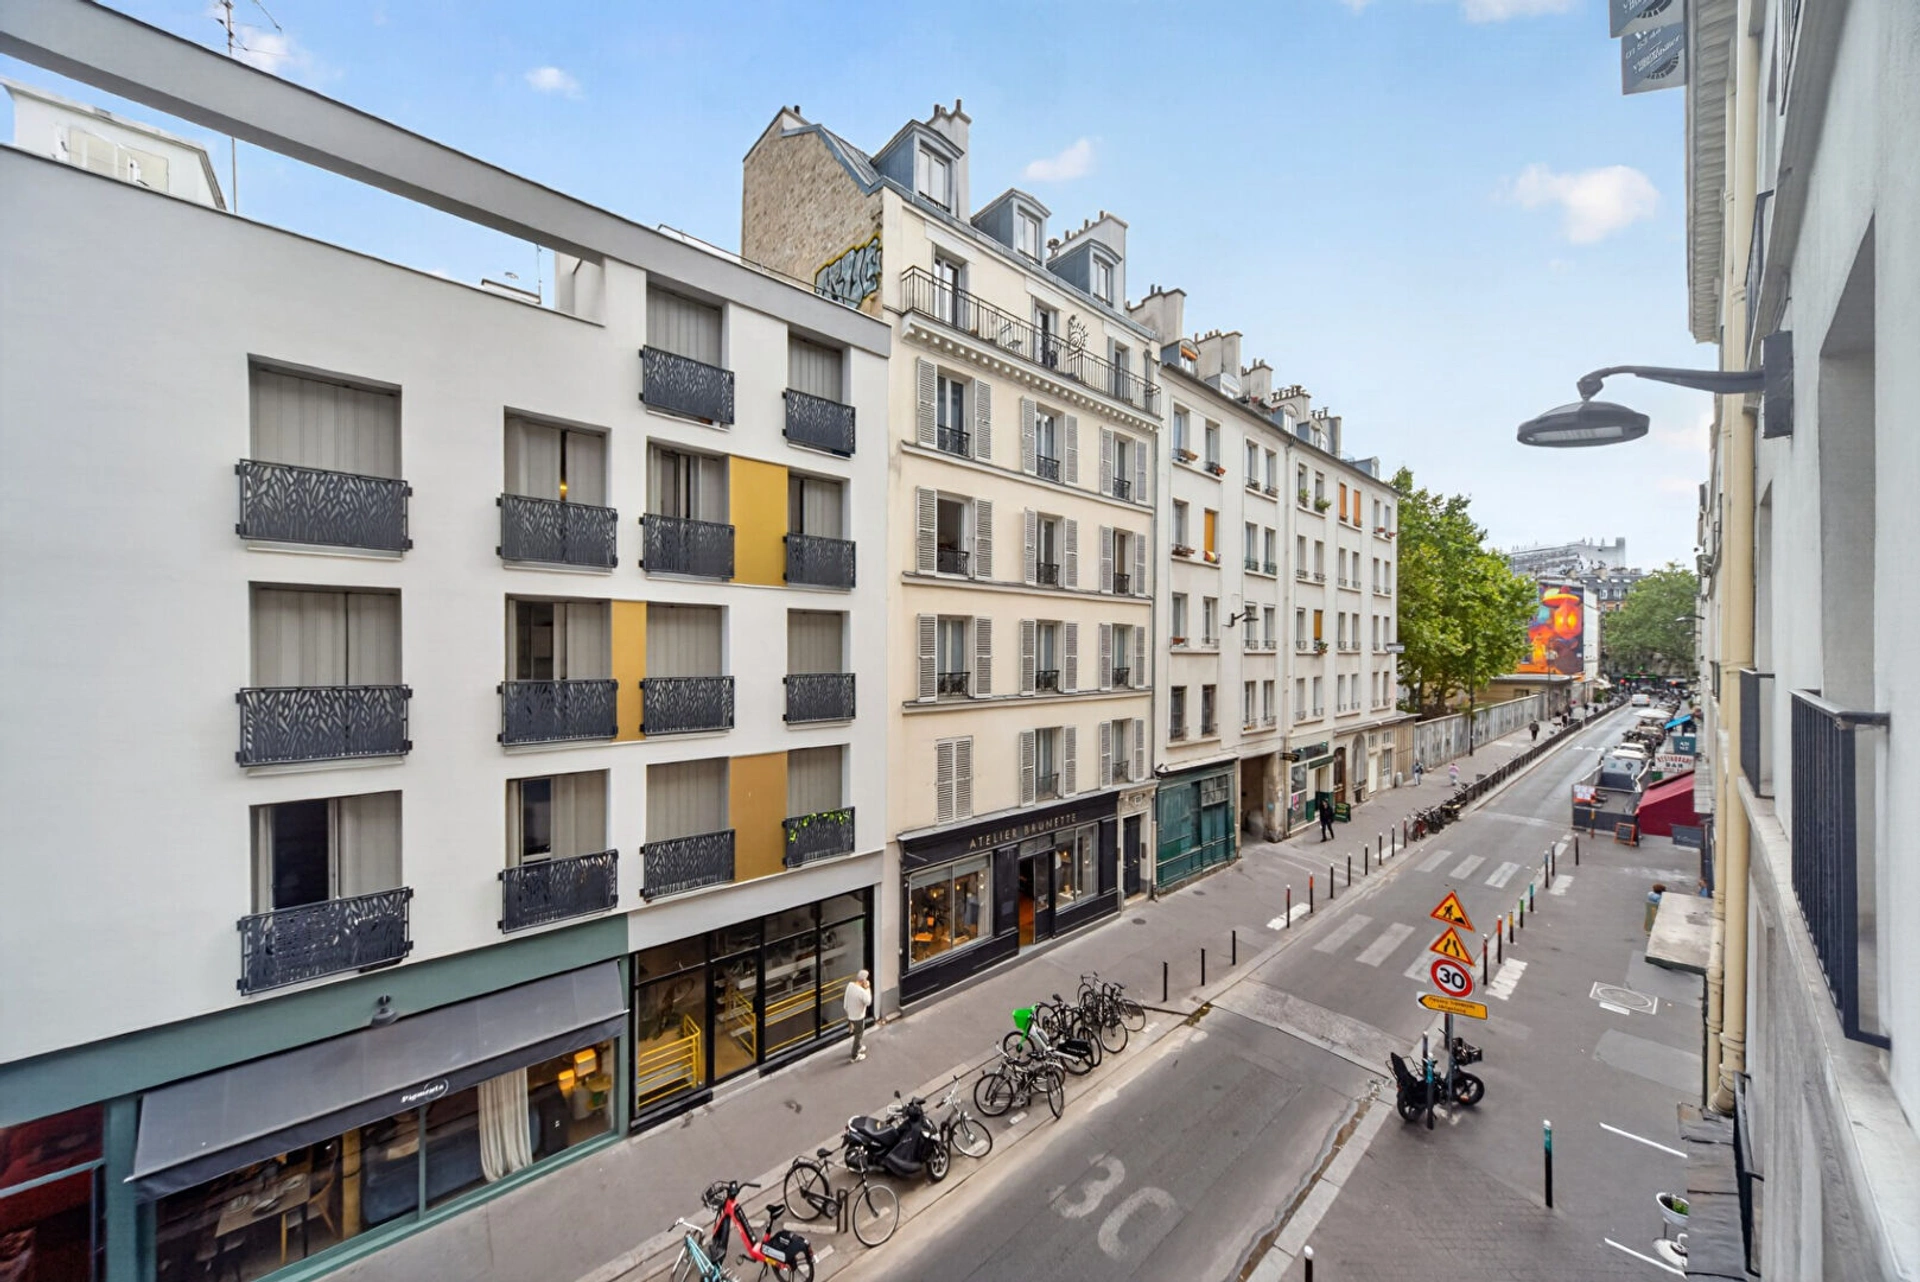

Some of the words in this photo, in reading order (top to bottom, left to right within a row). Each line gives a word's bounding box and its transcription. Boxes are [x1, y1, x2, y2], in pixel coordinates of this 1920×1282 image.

[969, 828, 1017, 850] ATELIER
[1023, 813, 1077, 836] BRUNETTE
[1439, 967, 1465, 990] 30
[1050, 1153, 1176, 1260] 30
